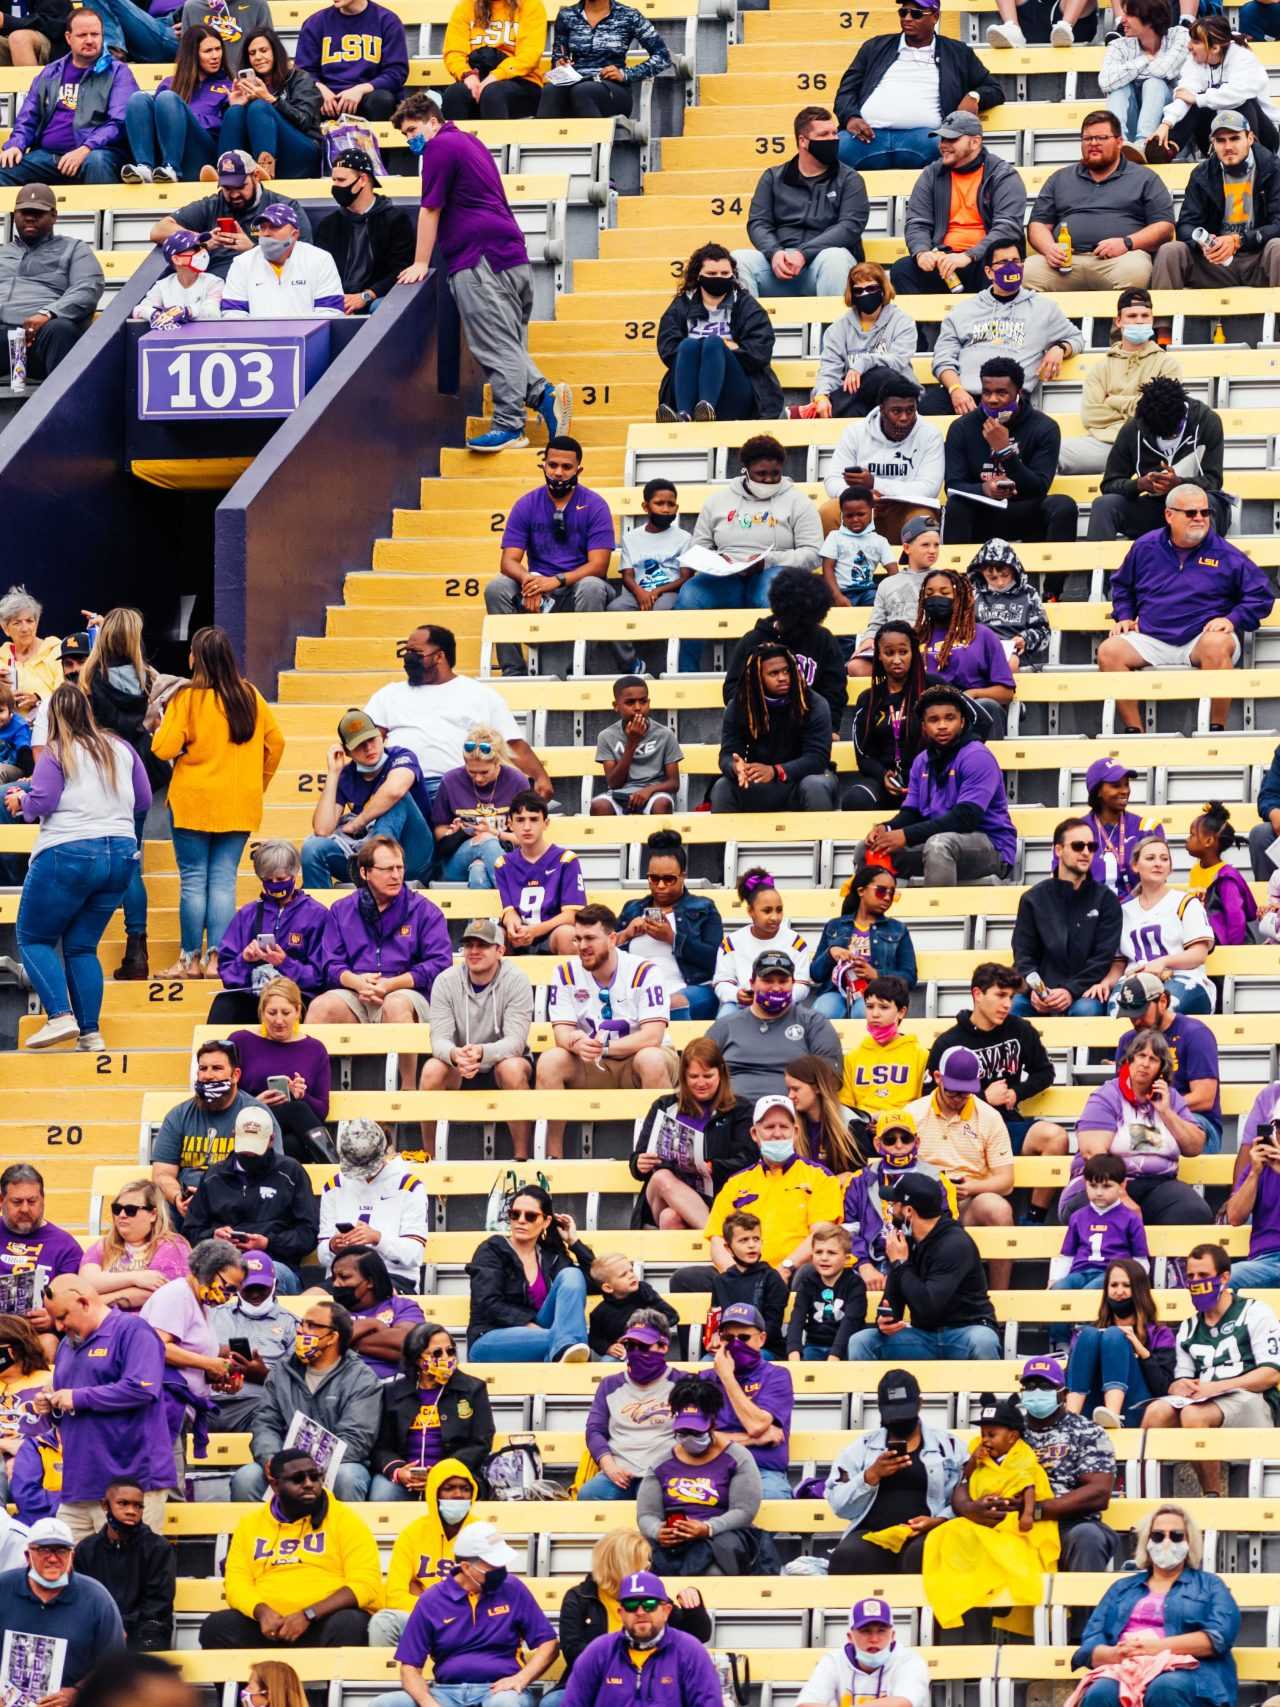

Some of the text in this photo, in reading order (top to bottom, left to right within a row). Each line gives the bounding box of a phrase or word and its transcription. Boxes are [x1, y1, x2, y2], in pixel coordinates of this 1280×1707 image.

[840, 12, 870, 29] 37
[322, 33, 383, 65] LSU
[798, 73, 827, 90] 36
[756, 137, 786, 154] 35
[712, 197, 743, 216] 34
[1003, 274, 1020, 283] LSU
[625, 321, 656, 339] 32
[168, 352, 274, 408] 103
[582, 386, 610, 404] 31
[868, 463, 908, 477] PUMA
[1198, 556, 1219, 568] LSU
[446, 579, 480, 597] 28
[614, 740, 657, 755] NKE
[298, 774, 328, 792] 25
[520, 886, 546, 924] 9
[1130, 924, 1168, 963] 10
[149, 982, 183, 1002] 22
[646, 986, 664, 1007] 18
[97, 1055, 128, 1074] 21
[856, 1065, 908, 1085] LSU
[48, 1126, 83, 1145] 20
[1087, 1233, 1105, 1262] 1
[88, 1348, 108, 1357] LSU
[1030, 1362, 1051, 1371] LSU
[254, 1532, 325, 1561] LSU
[417, 1555, 455, 1579] LS
[629, 1575, 645, 1593] L
[487, 1604, 510, 1617] LSU
